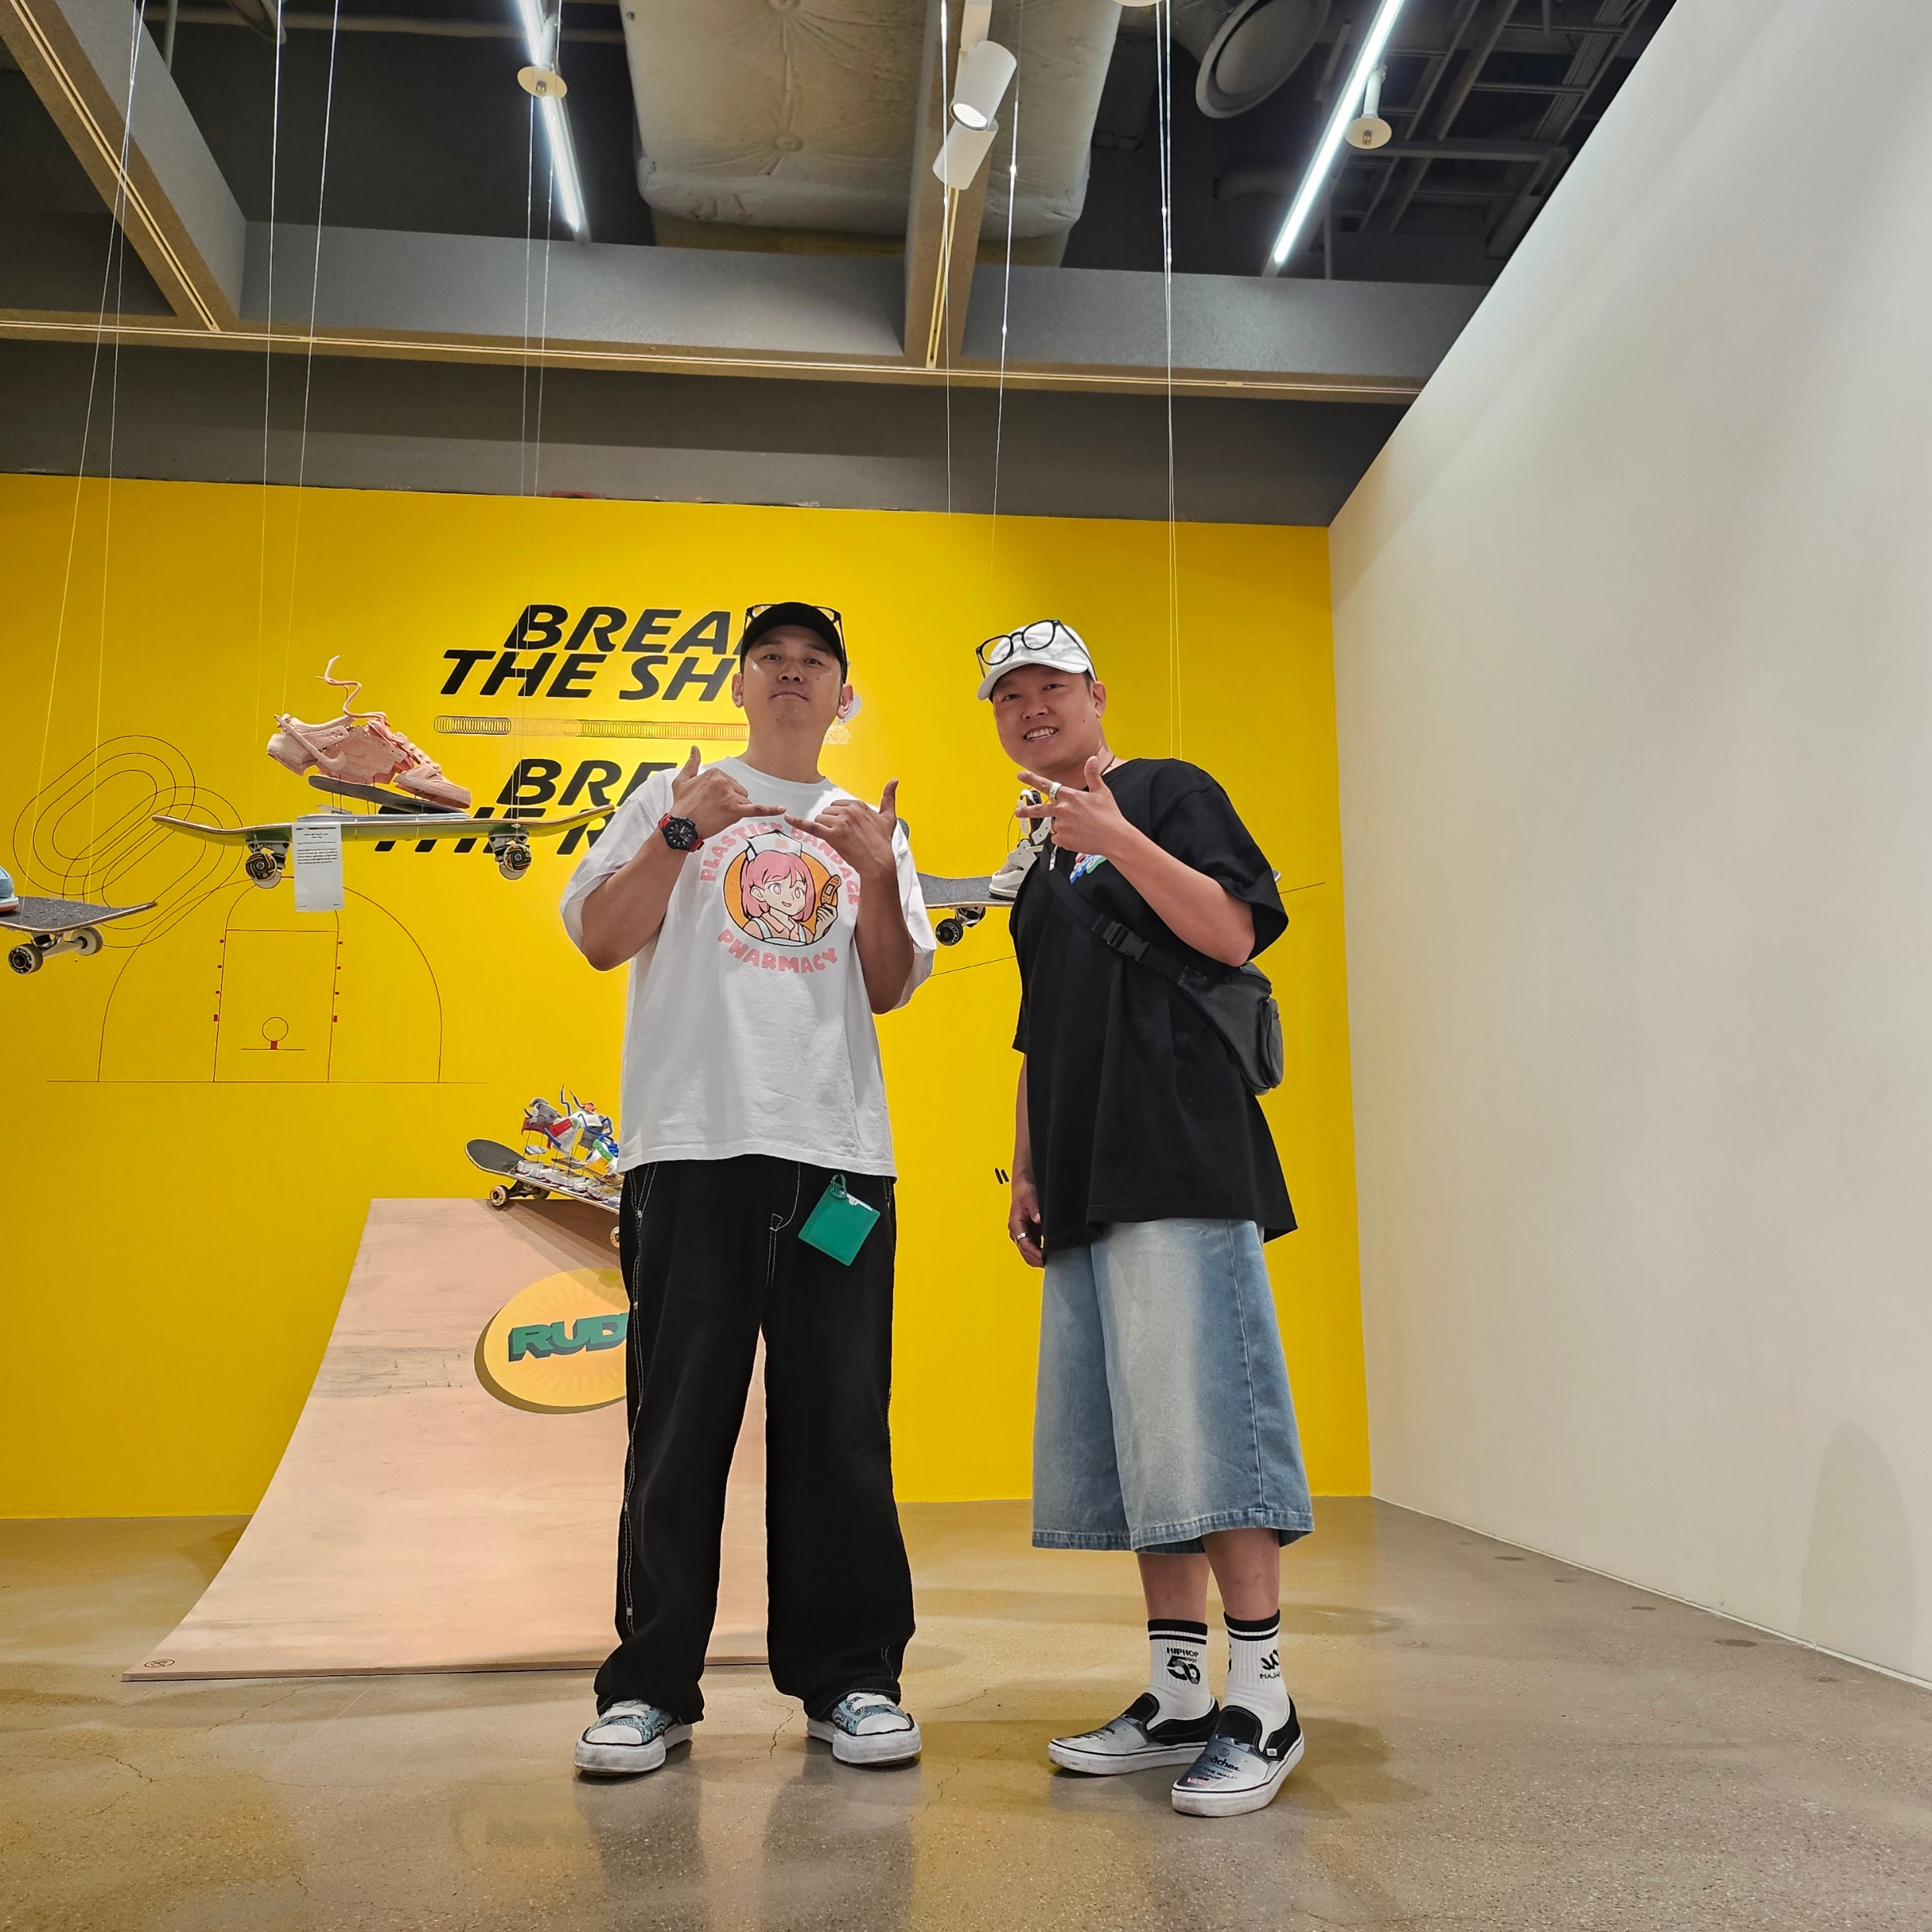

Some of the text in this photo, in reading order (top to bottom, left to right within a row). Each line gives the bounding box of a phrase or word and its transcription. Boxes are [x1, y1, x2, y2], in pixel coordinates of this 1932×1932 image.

[503, 604, 741, 655] BREA
[441, 649, 736, 702] THE SH
[496, 758, 678, 808] BRE
[790, 826, 860, 905] BANDAGE
[717, 928, 838, 973] PHARMACY
[508, 1313, 629, 1363] RUD
[1166, 1646, 1199, 1657] HIPHOP
